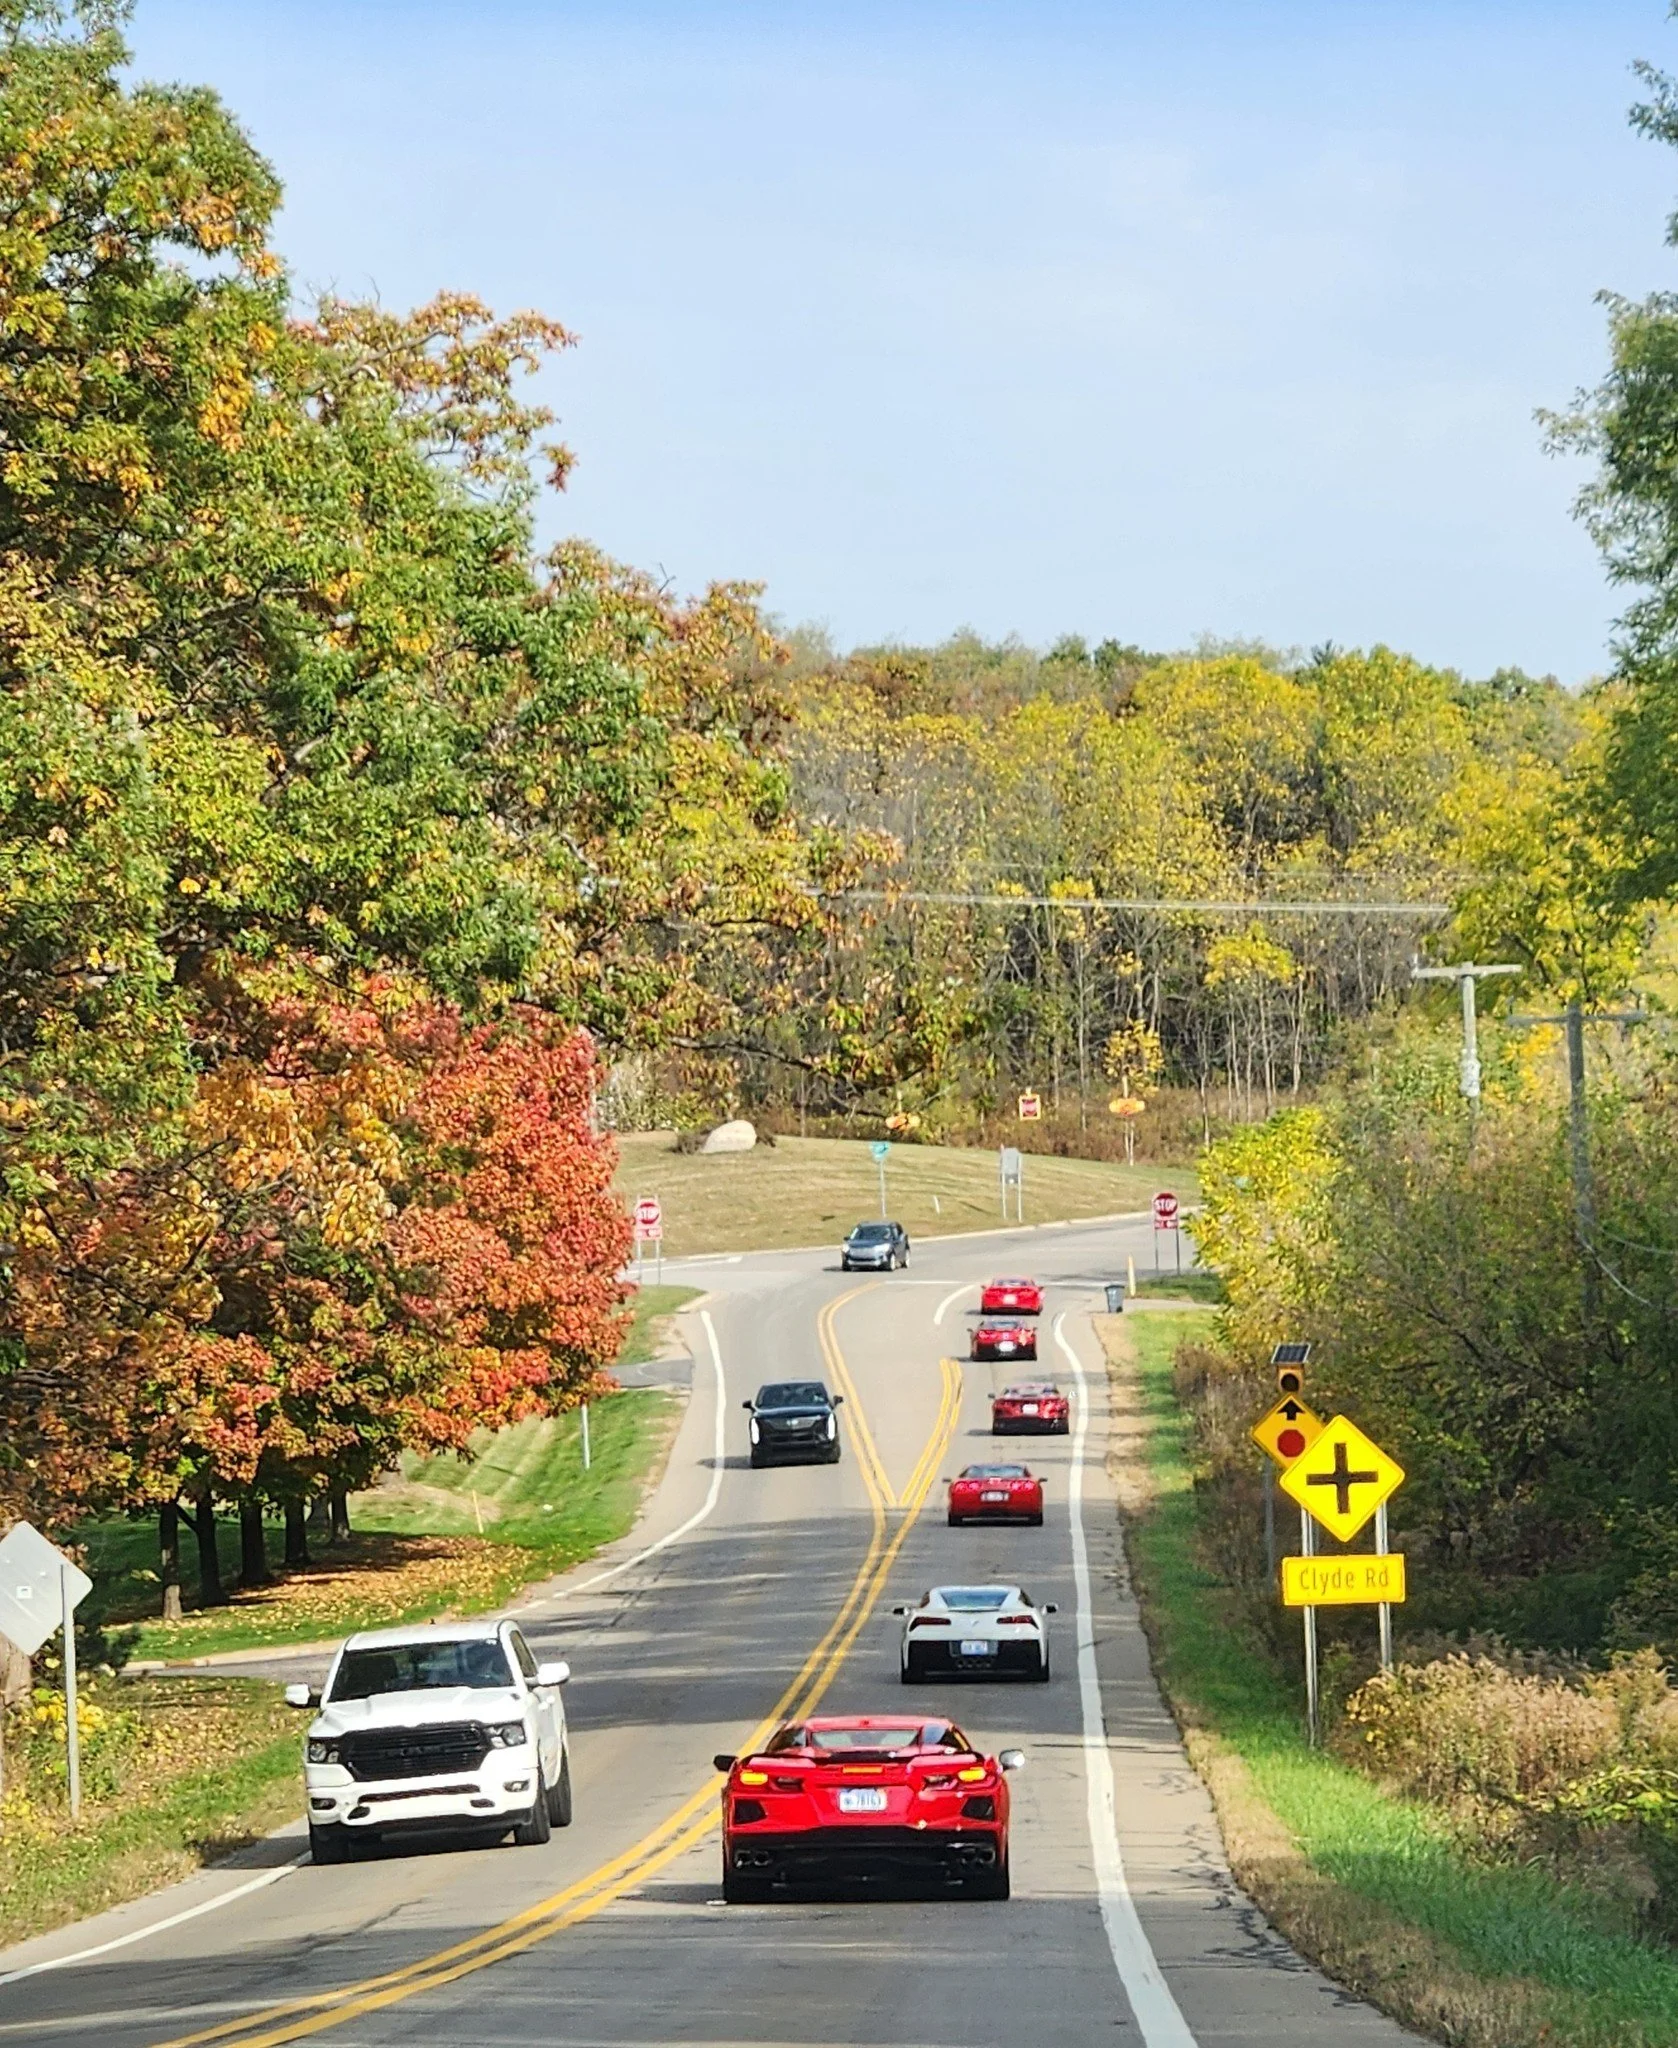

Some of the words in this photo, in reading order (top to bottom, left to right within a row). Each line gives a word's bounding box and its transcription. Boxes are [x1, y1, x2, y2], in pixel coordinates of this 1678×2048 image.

[1154, 1199, 1177, 1212] STOP
[636, 1207, 658, 1220] STOP
[1300, 1567, 1355, 1595] Clyde
[1366, 1566, 1389, 1588] Rd
